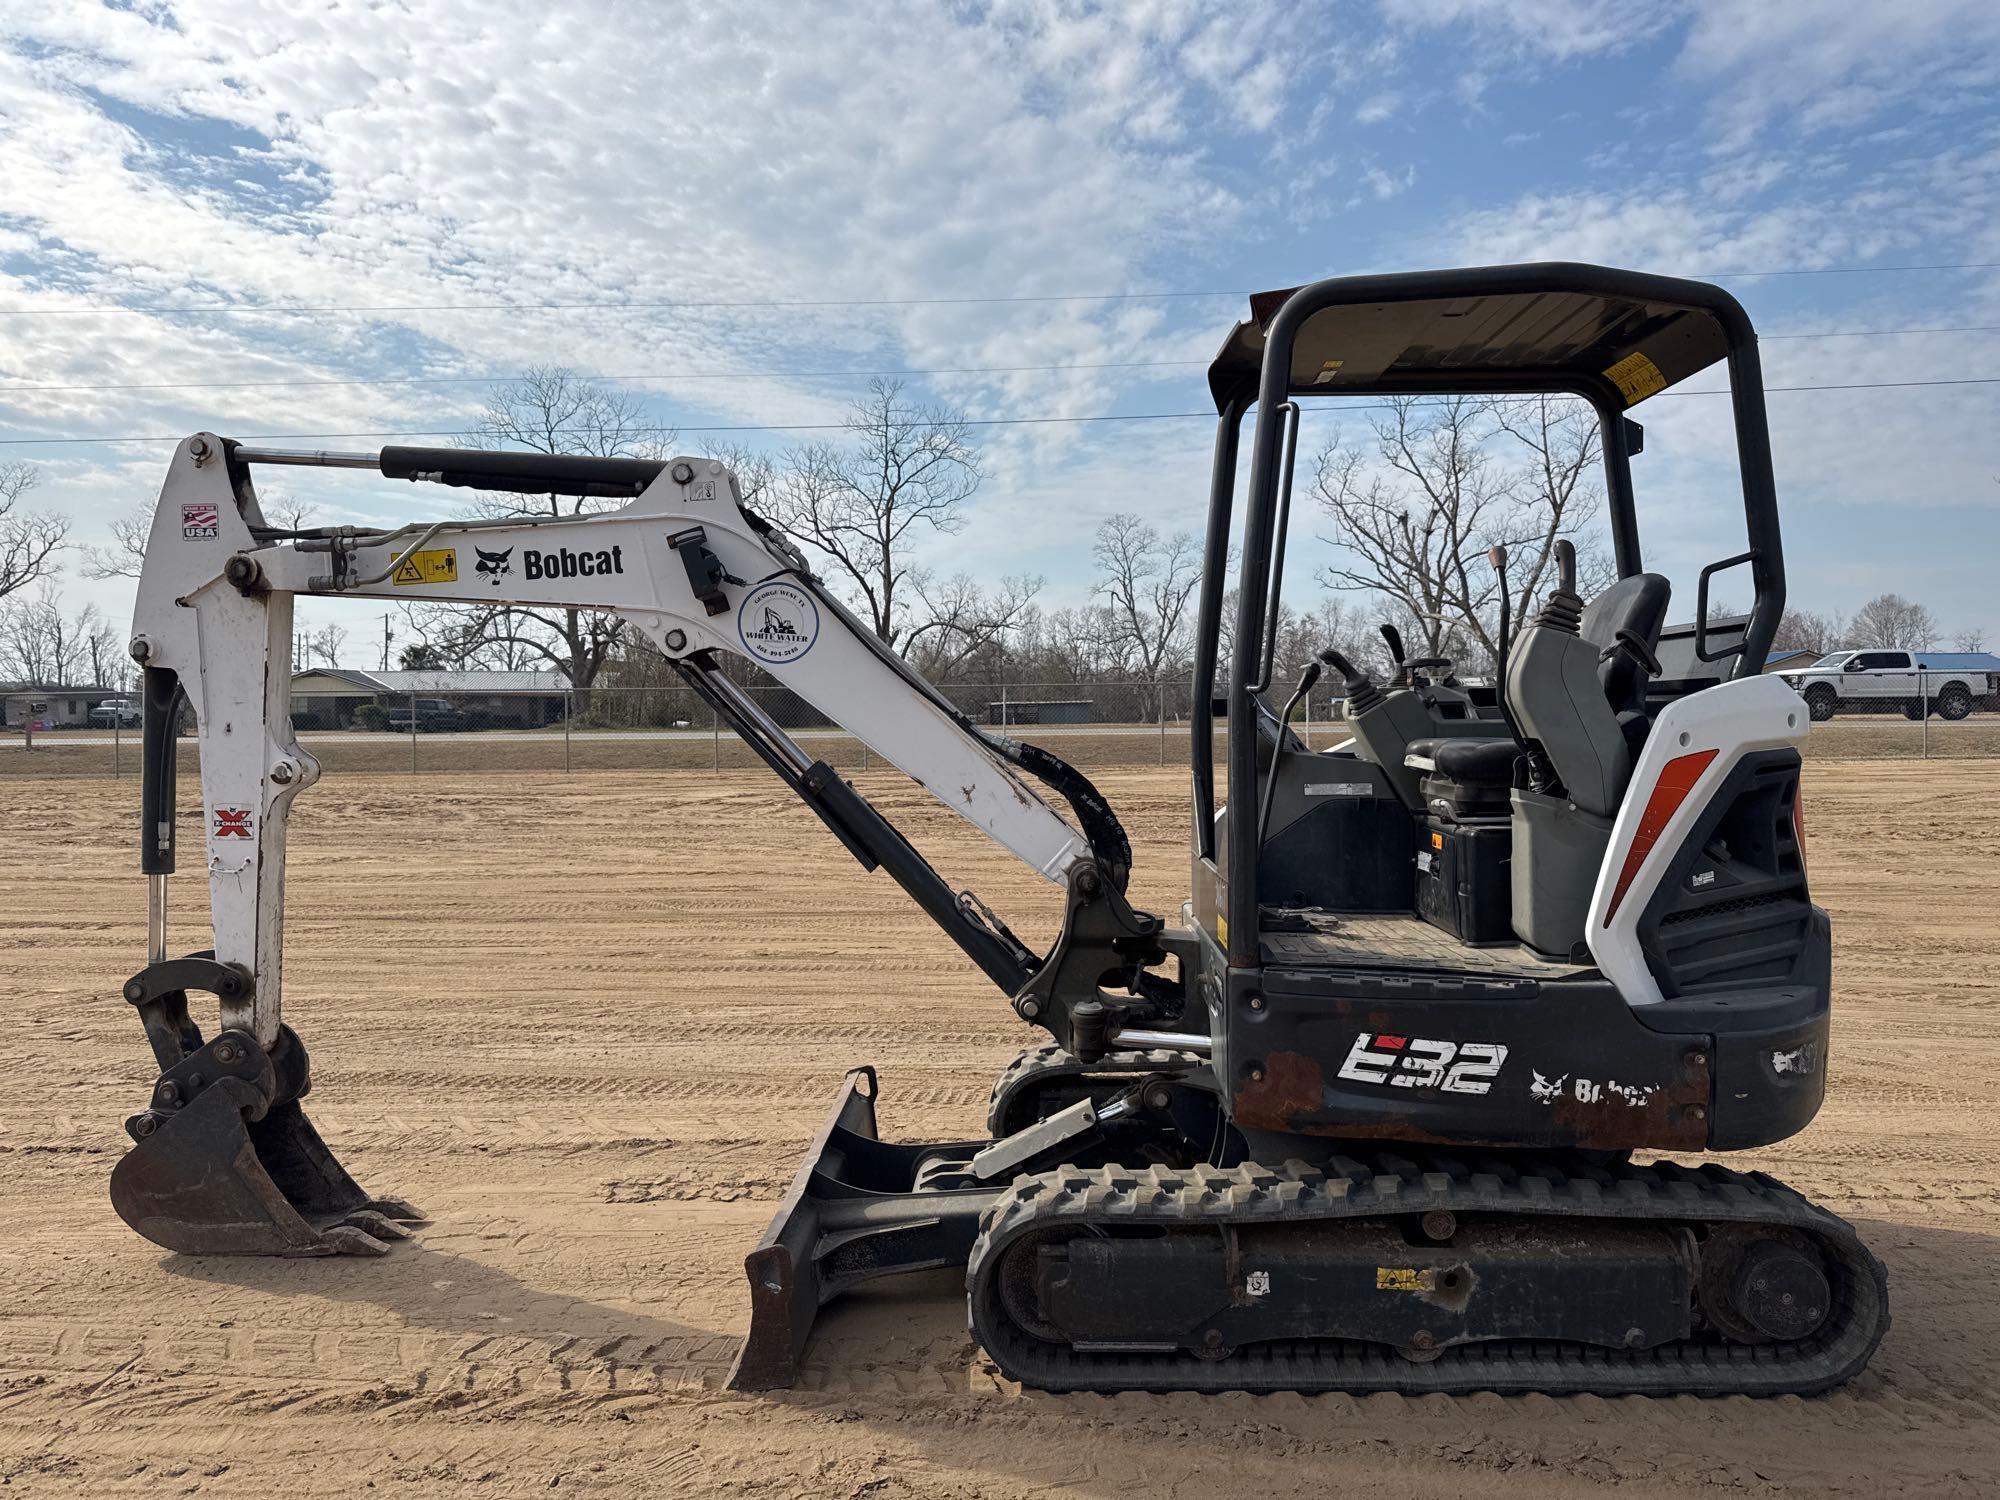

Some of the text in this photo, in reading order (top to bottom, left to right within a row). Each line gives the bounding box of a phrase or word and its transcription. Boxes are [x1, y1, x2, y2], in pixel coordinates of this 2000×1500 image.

[185, 528, 215, 537] USA
[523, 545, 624, 580] Bobcat
[746, 632, 775, 640] WHITE
[777, 633, 808, 642] WATER
[1337, 1033, 1508, 1094] E32
